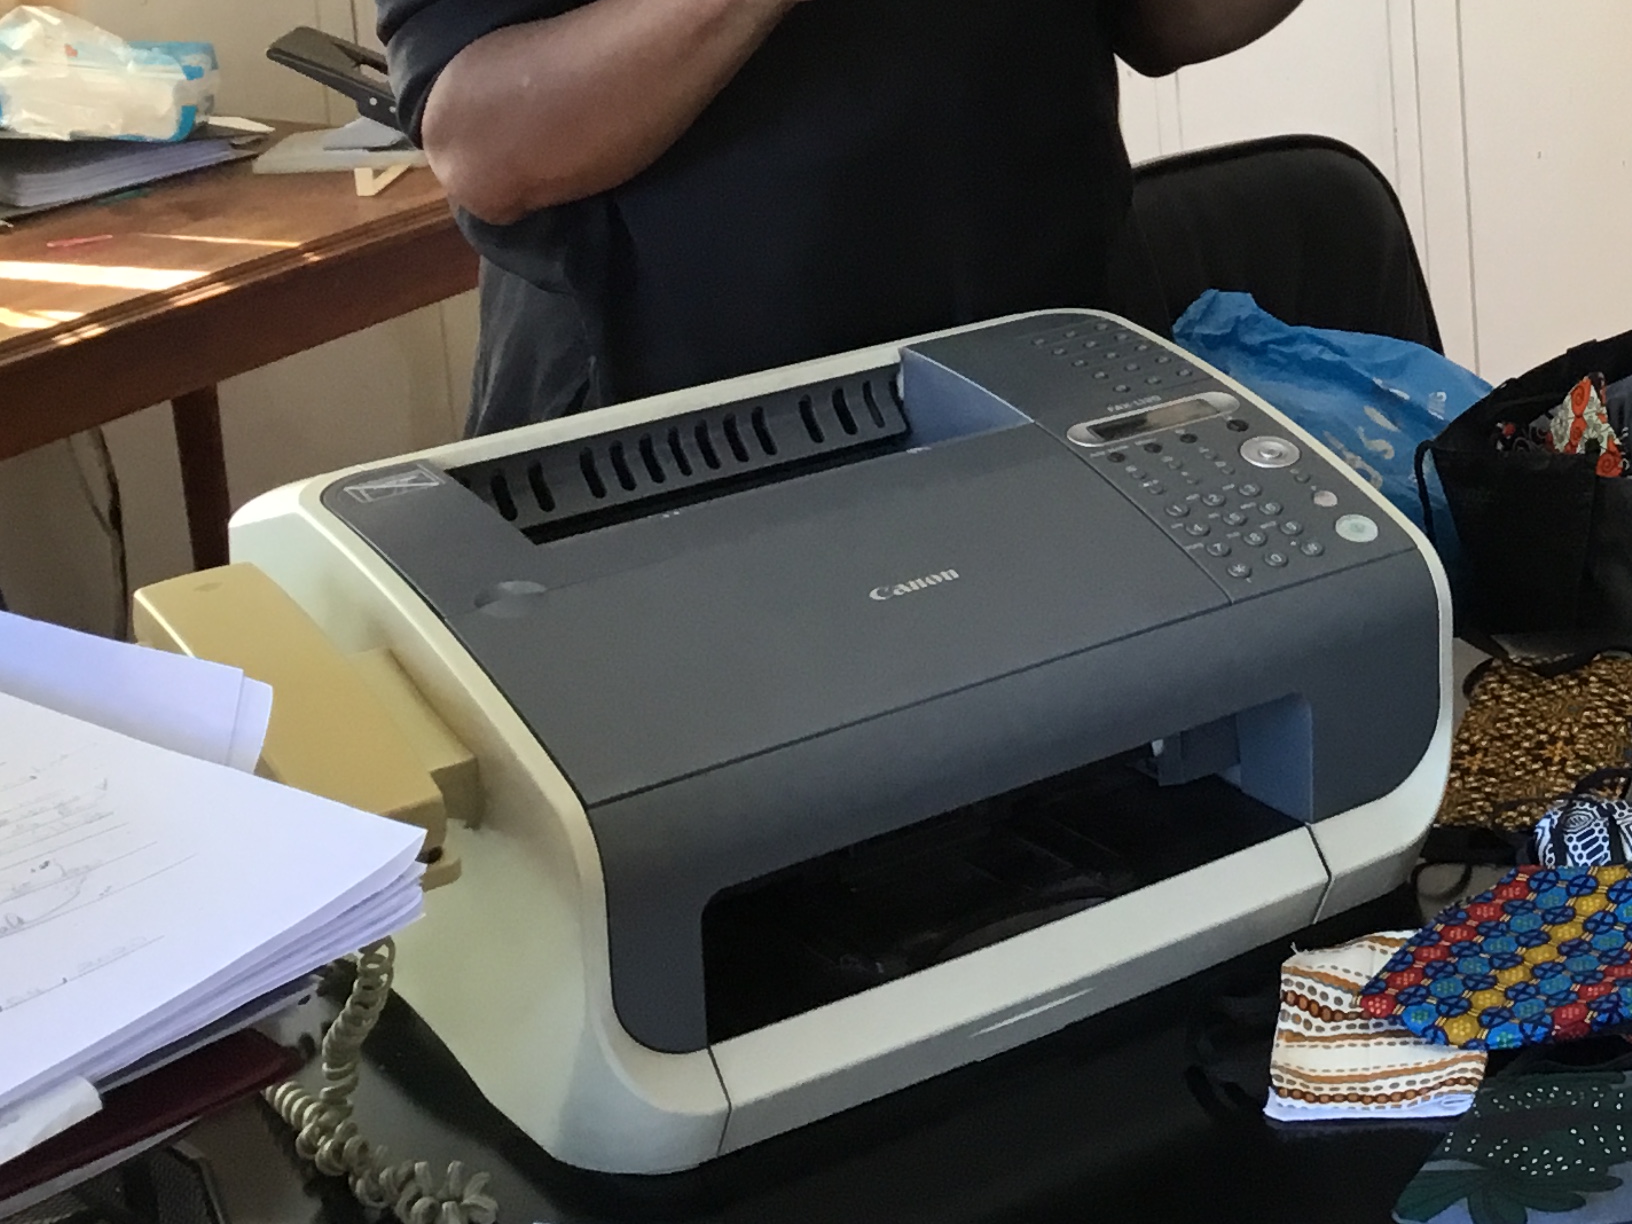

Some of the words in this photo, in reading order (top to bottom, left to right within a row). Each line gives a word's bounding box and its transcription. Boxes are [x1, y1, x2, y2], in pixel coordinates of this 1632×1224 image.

[1208, 494, 1220, 503] 2
[1270, 553, 1282, 563] 0
[869, 569, 960, 600] Canon
